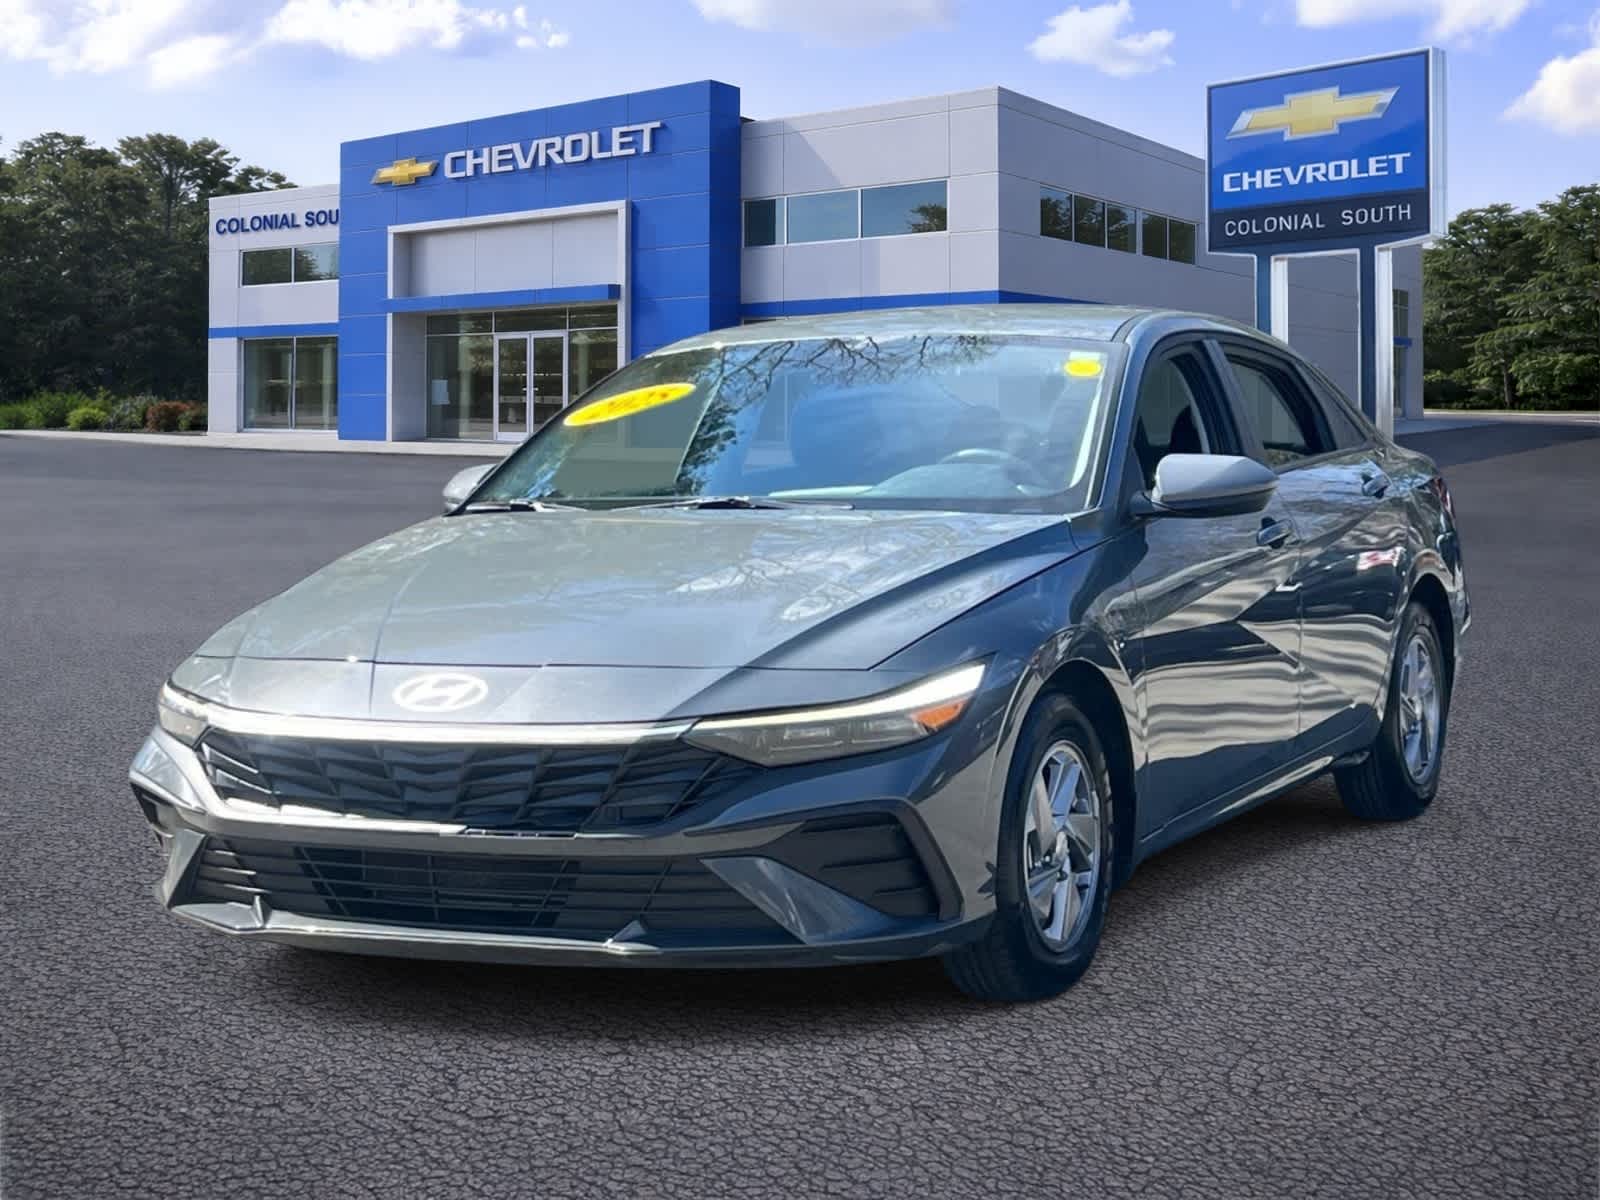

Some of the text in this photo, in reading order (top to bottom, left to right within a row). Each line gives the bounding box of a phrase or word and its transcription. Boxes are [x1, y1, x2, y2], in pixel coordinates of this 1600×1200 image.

[443, 121, 663, 179] CHEVROLET
[1223, 152, 1411, 192] CHEVROLET
[215, 212, 300, 235] COLONIAL
[1224, 203, 1412, 236] COLONIAL SOUTH
